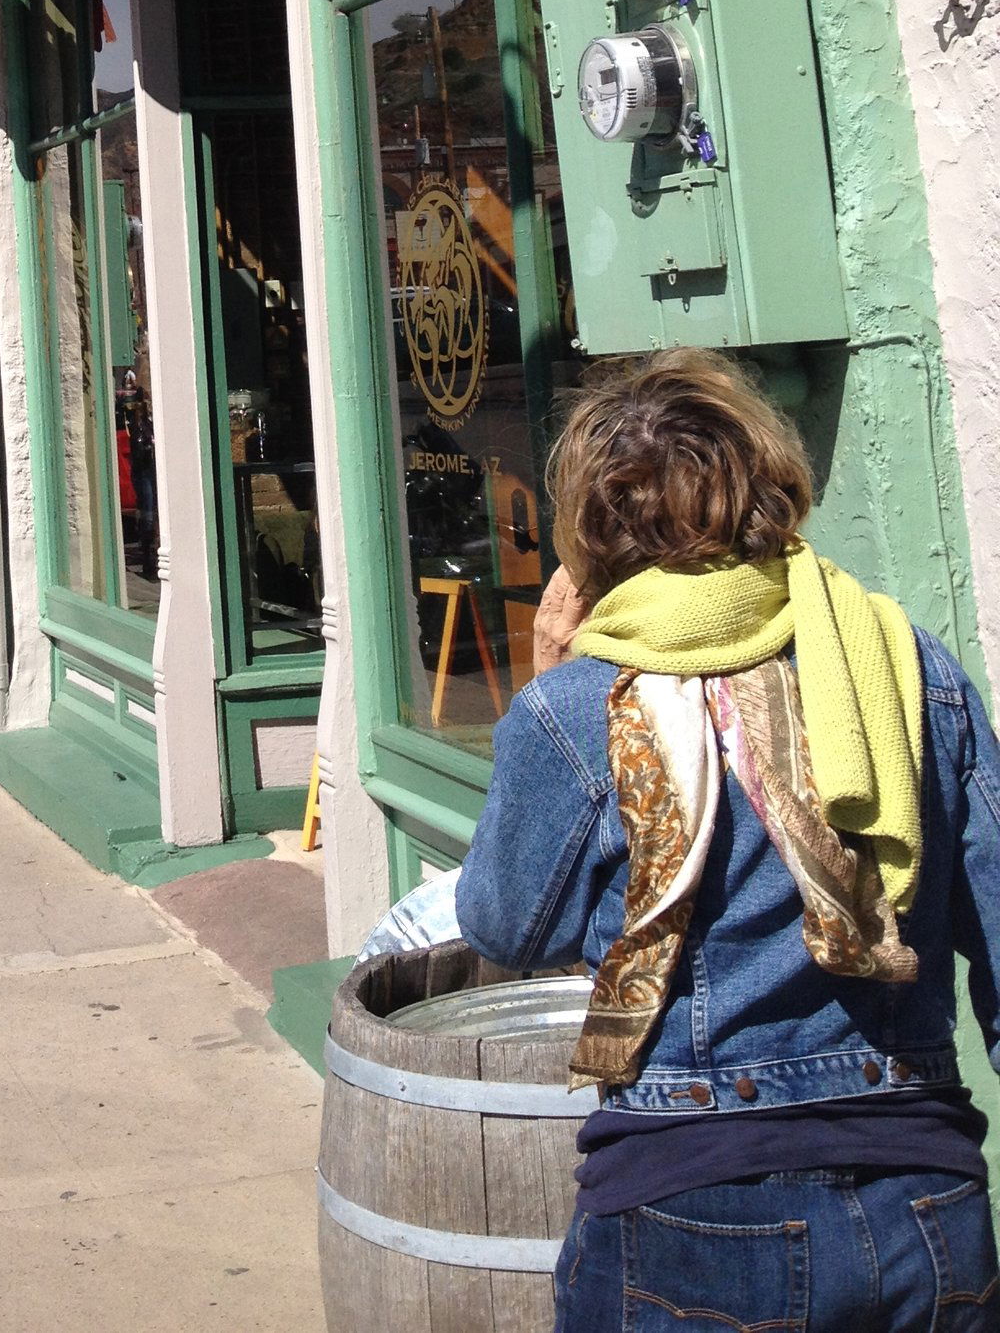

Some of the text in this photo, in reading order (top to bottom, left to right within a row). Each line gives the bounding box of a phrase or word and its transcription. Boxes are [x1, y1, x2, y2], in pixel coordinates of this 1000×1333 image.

[426, 406, 465, 432] MERKIN
[409, 451, 502, 476] JEROME, AZ
